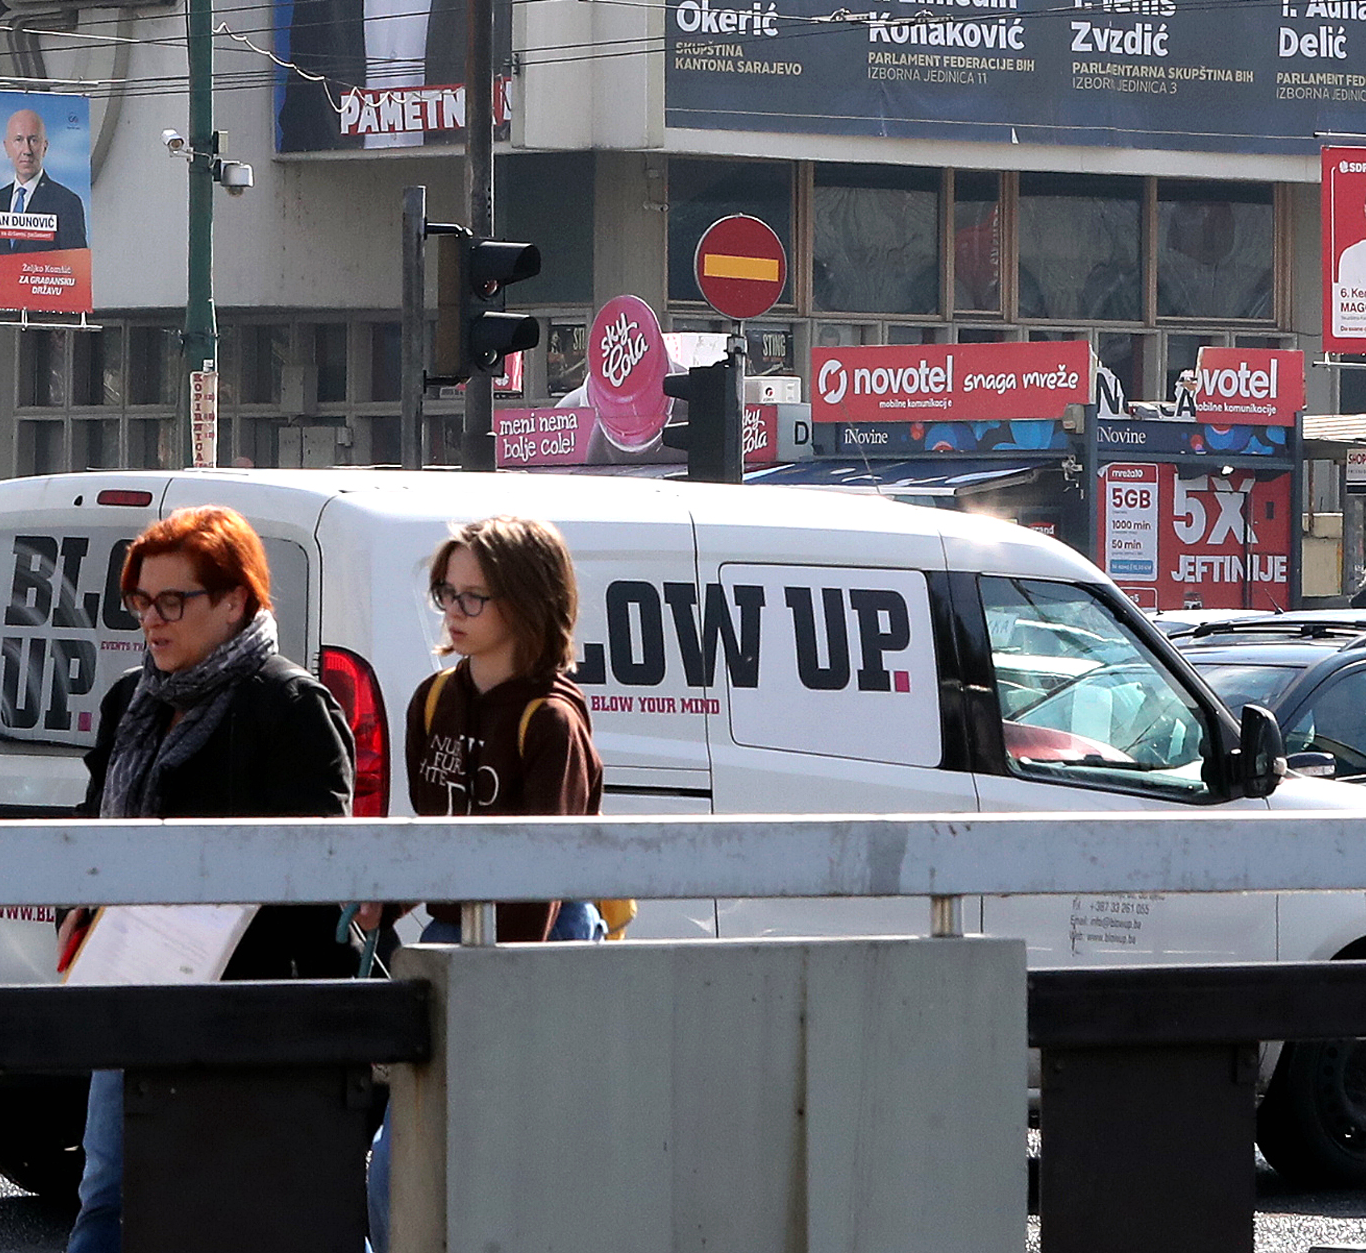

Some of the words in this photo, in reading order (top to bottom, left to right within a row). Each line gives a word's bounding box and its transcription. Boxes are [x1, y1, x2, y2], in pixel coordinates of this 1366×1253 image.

[677, 0, 779, 37] Okerić
[1279, 26, 1348, 59] Delić
[675, 57, 734, 73] KANTONA
[737, 60, 802, 75] SARAJEVO
[868, 52, 940, 68] PARLAMENT
[943, 55, 1014, 71] FEDERACIJE
[1016, 58, 1035, 72] BIH
[868, 67, 920, 81] IZBORNA
[924, 69, 975, 84] JEDINICA
[977, 72, 987, 84] 11
[1168, 65, 1233, 82] SKUPŠTINA
[1235, 70, 1254, 82] BIH
[1277, 72, 1344, 87] PARLAMENT
[1169, 81, 1177, 94] 3
[1276, 86, 1330, 100] IZBORNA
[340, 88, 466, 134] PAMETN
[19, 276, 30, 284] ZA
[1340, 288, 1350, 298] 6.
[600, 311, 638, 358] sky
[762, 333, 786, 358] STING
[603, 331, 649, 388] Cola
[854, 355, 953, 395] novotel
[963, 371, 1017, 395] snaga
[1022, 363, 1078, 390] mreže
[879, 398, 906, 409] mobilne
[1224, 403, 1277, 416] komunikacije
[499, 410, 536, 436] meni
[539, 412, 578, 431] nema
[503, 436, 536, 462] bolje
[540, 434, 576, 455] cole!
[1112, 488, 1151, 508] 5GB
[1173, 473, 1259, 545] 5X
[1112, 520, 1132, 530] 1000
[1133, 521, 1151, 530] min
[1111, 539, 1123, 549] 50
[1124, 541, 1142, 549] min
[1171, 554, 1287, 582] JEFTINIJE
[784, 587, 911, 693] UP.
[0, 636, 92, 732] UP.
[591, 696, 633, 712] BLOW
[638, 697, 676, 714] YOUR
[681, 697, 720, 715] MIND
